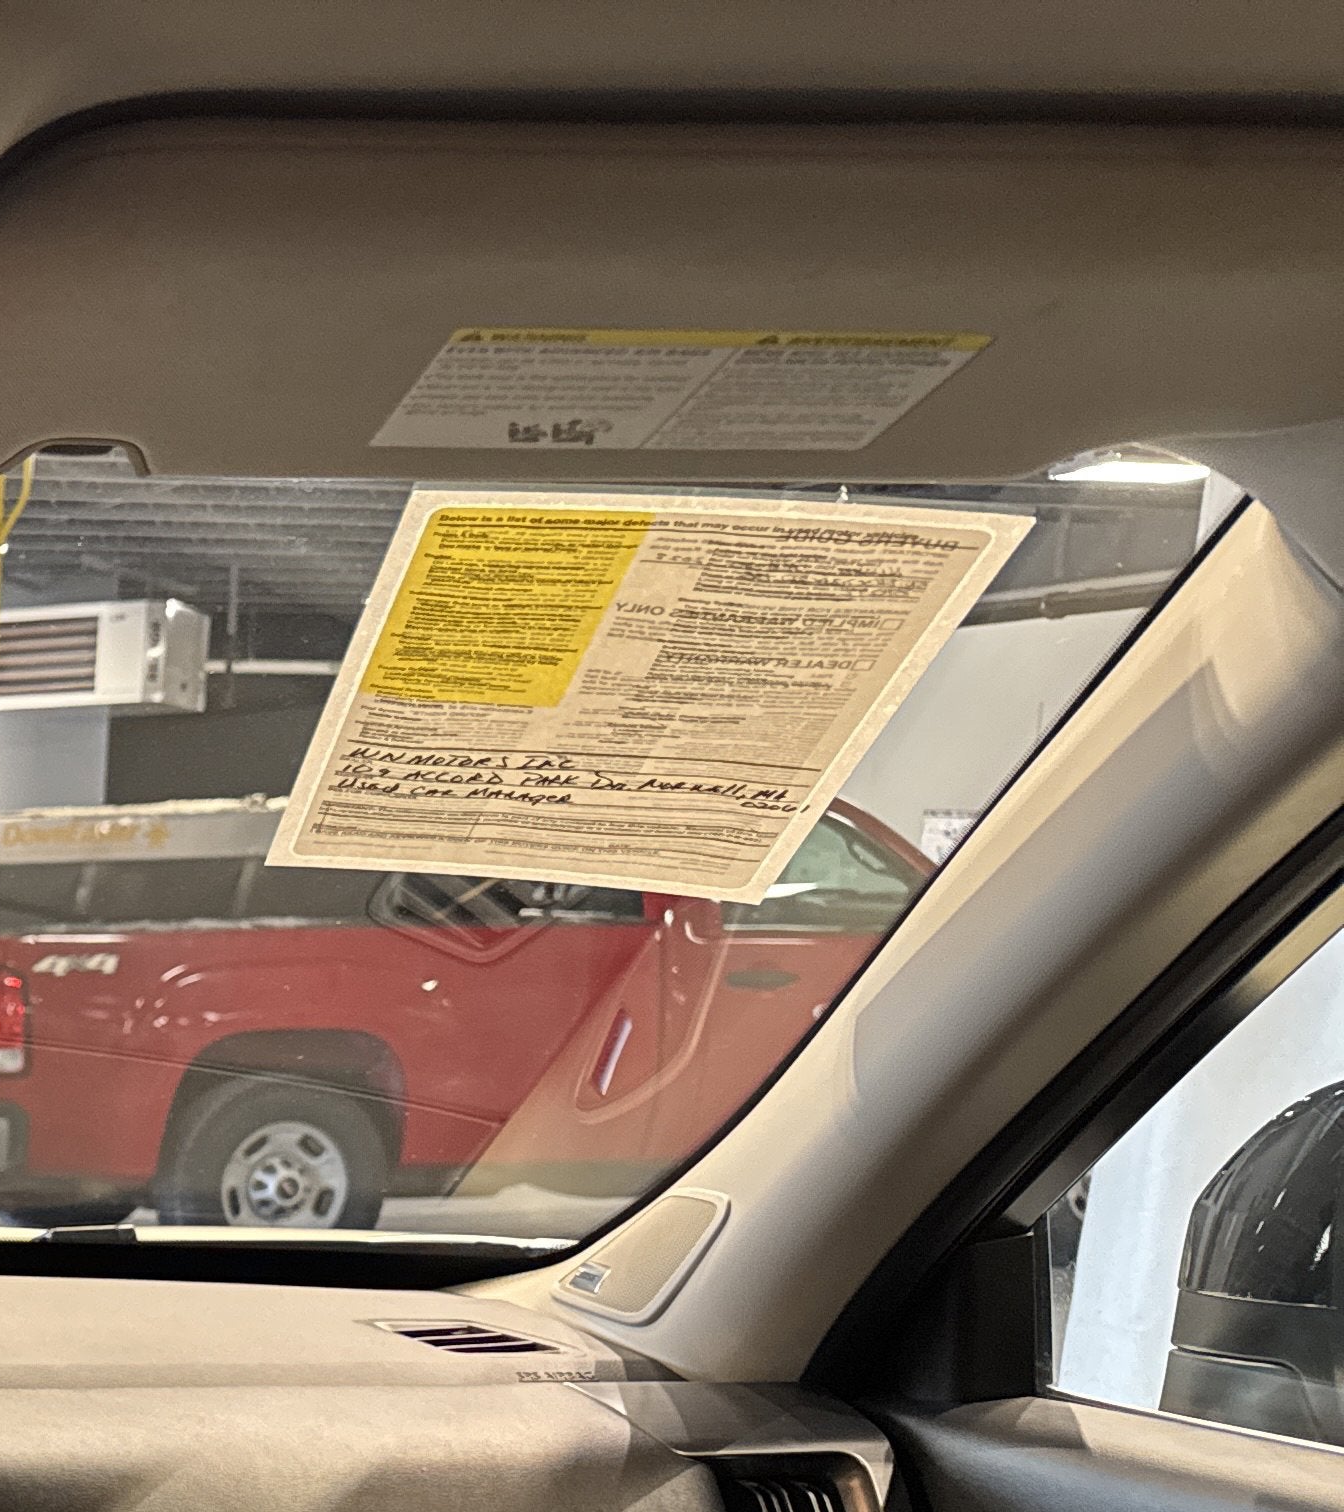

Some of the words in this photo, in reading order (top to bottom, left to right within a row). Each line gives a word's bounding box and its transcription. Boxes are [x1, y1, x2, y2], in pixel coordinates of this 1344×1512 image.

[530, 516, 544, 524] of
[545, 517, 580, 525] some
[584, 517, 620, 527] major
[623, 519, 670, 527] defects
[673, 520, 699, 528] that
[701, 522, 729, 530] may
[732, 524, 770, 533] occur
[773, 525, 786, 533] in
[403, 770, 504, 785] ACCORD
